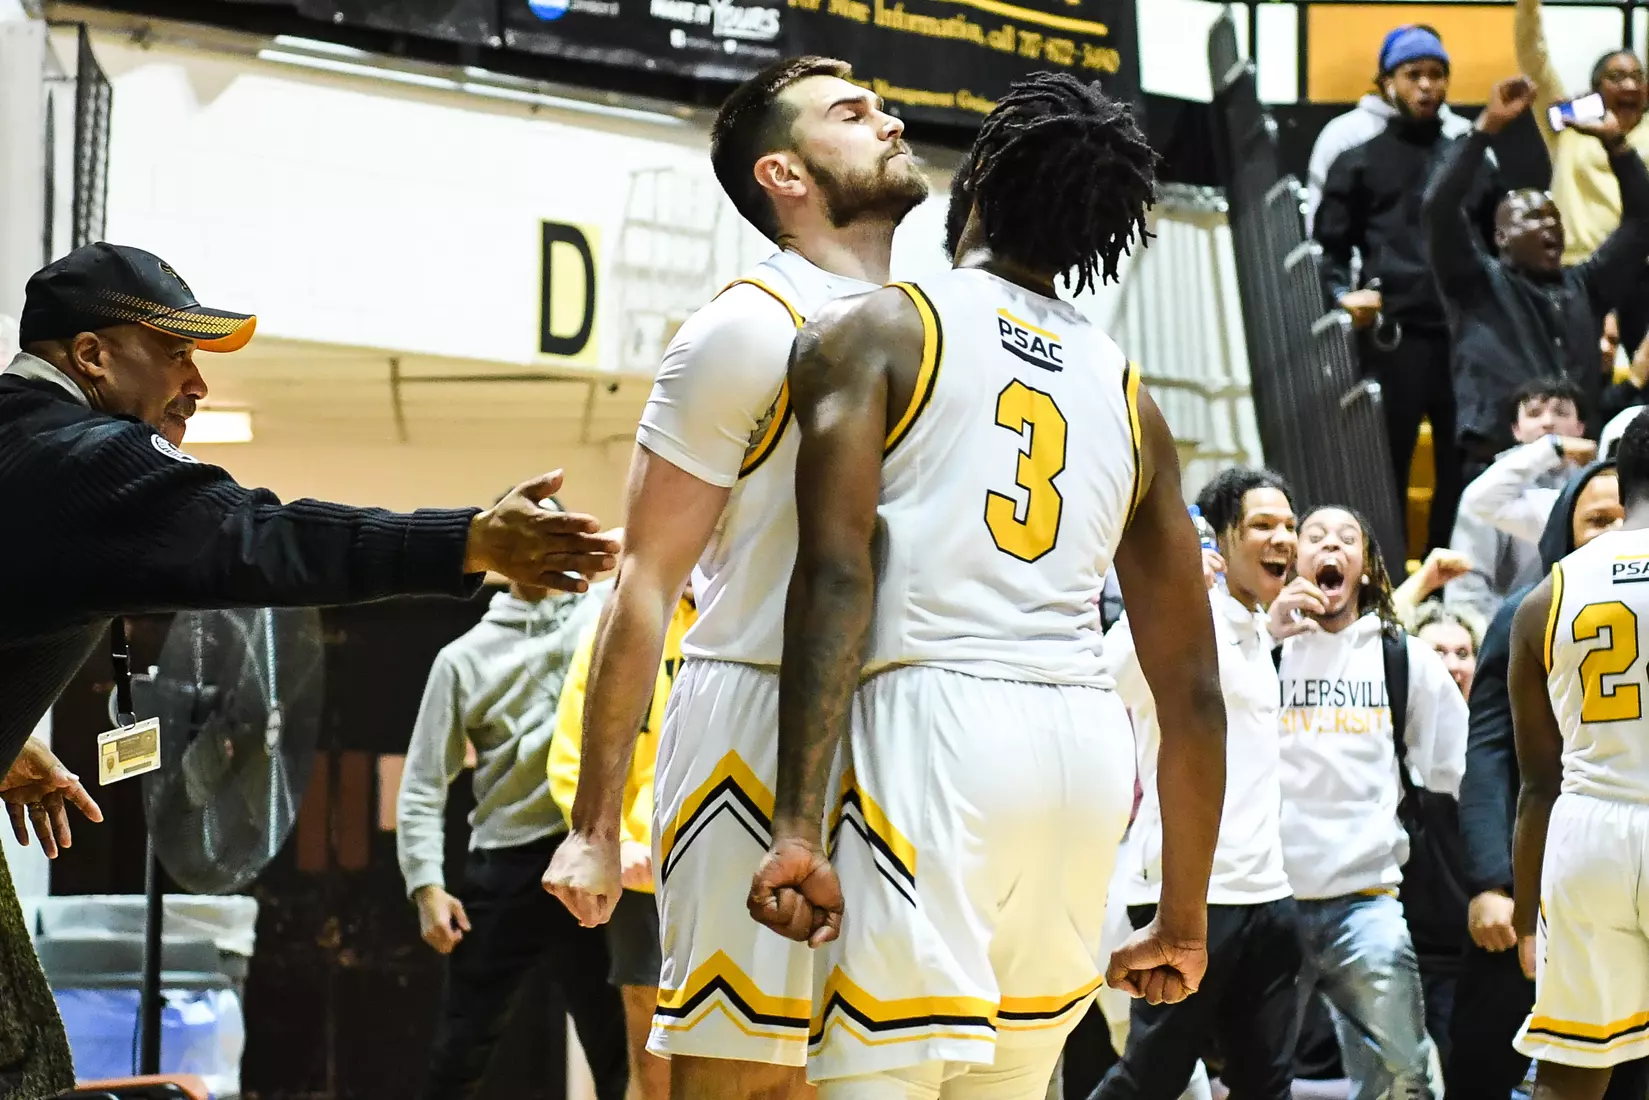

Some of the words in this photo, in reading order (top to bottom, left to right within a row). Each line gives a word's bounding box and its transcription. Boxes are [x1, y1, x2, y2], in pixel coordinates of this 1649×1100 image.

[541, 221, 596, 356] D
[998, 316, 1064, 364] PSAC
[984, 377, 1068, 564] 3
[1572, 601, 1649, 724] 2
